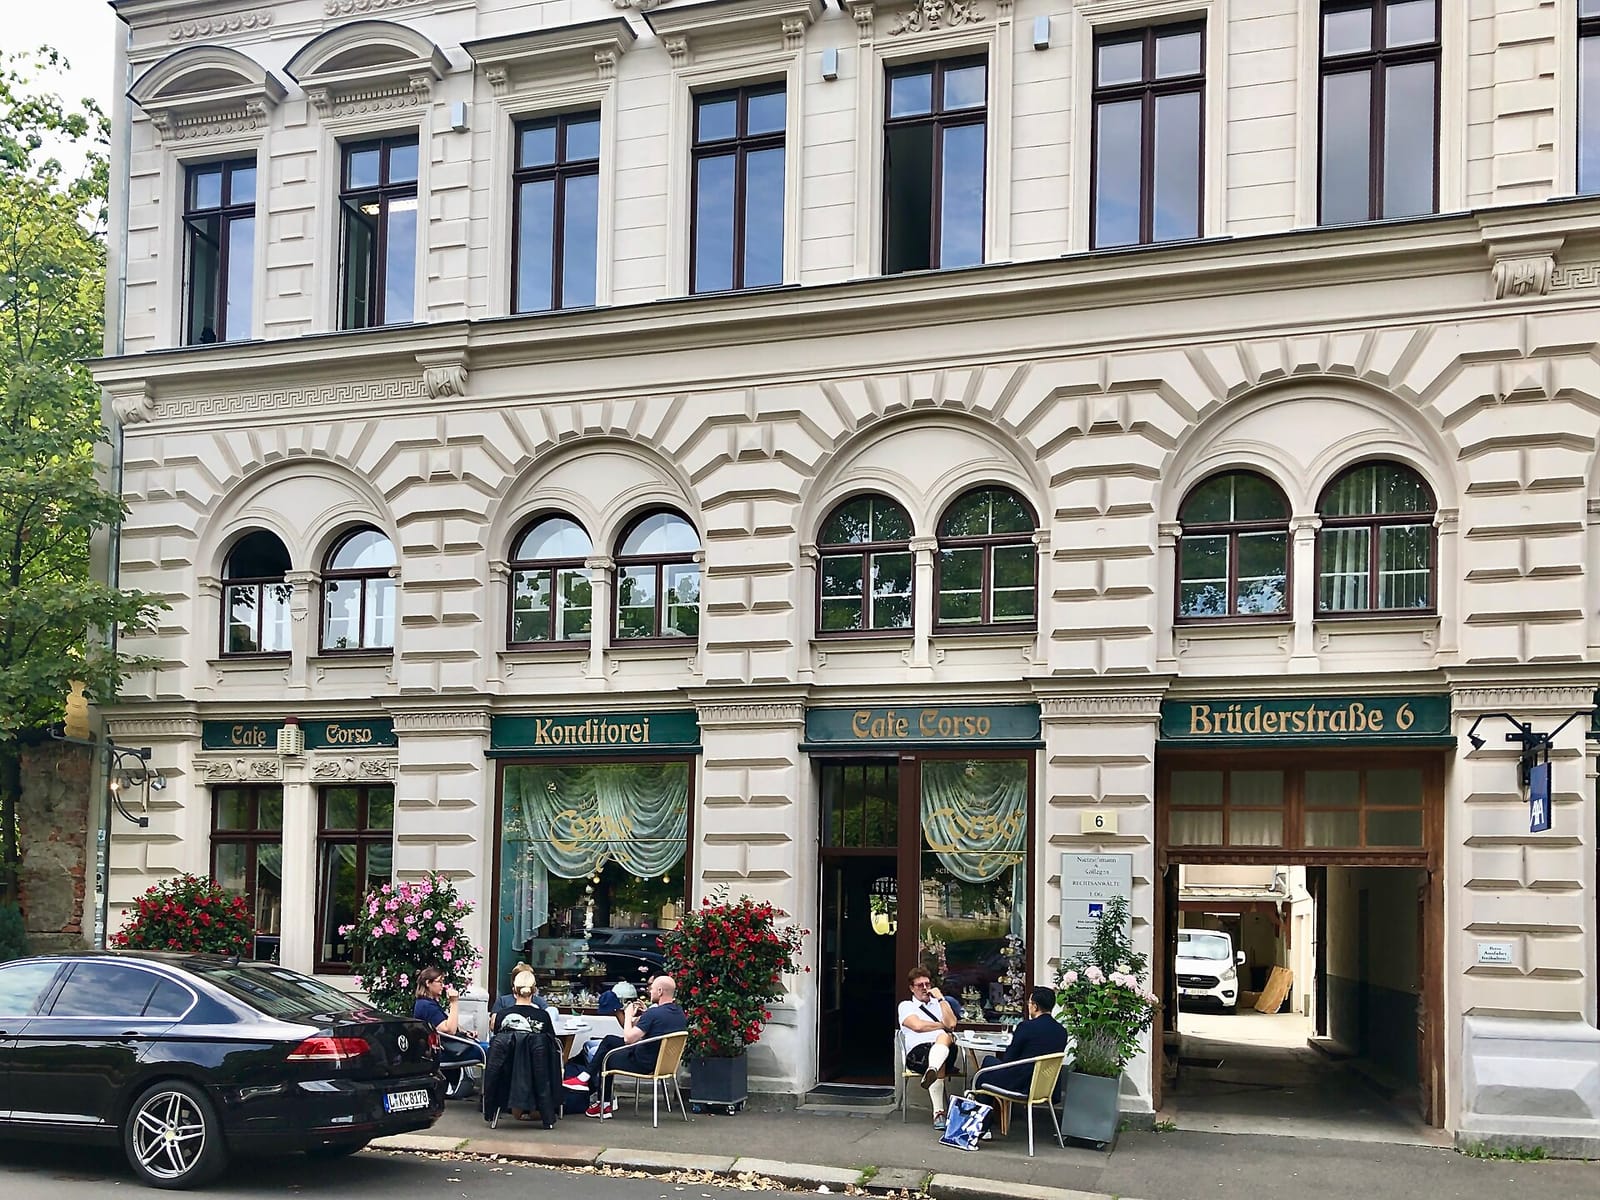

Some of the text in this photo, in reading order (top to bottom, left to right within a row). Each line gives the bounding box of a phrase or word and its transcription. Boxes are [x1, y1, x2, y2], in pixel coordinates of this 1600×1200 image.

[534, 717, 650, 745] Konditorei
[919, 709, 991, 737] Corso
[1190, 703, 1415, 734] Brüderstraße 6
[326, 724, 372, 744] Corso
[924, 807, 1020, 852] Corso
[1095, 815, 1104, 828] 6
